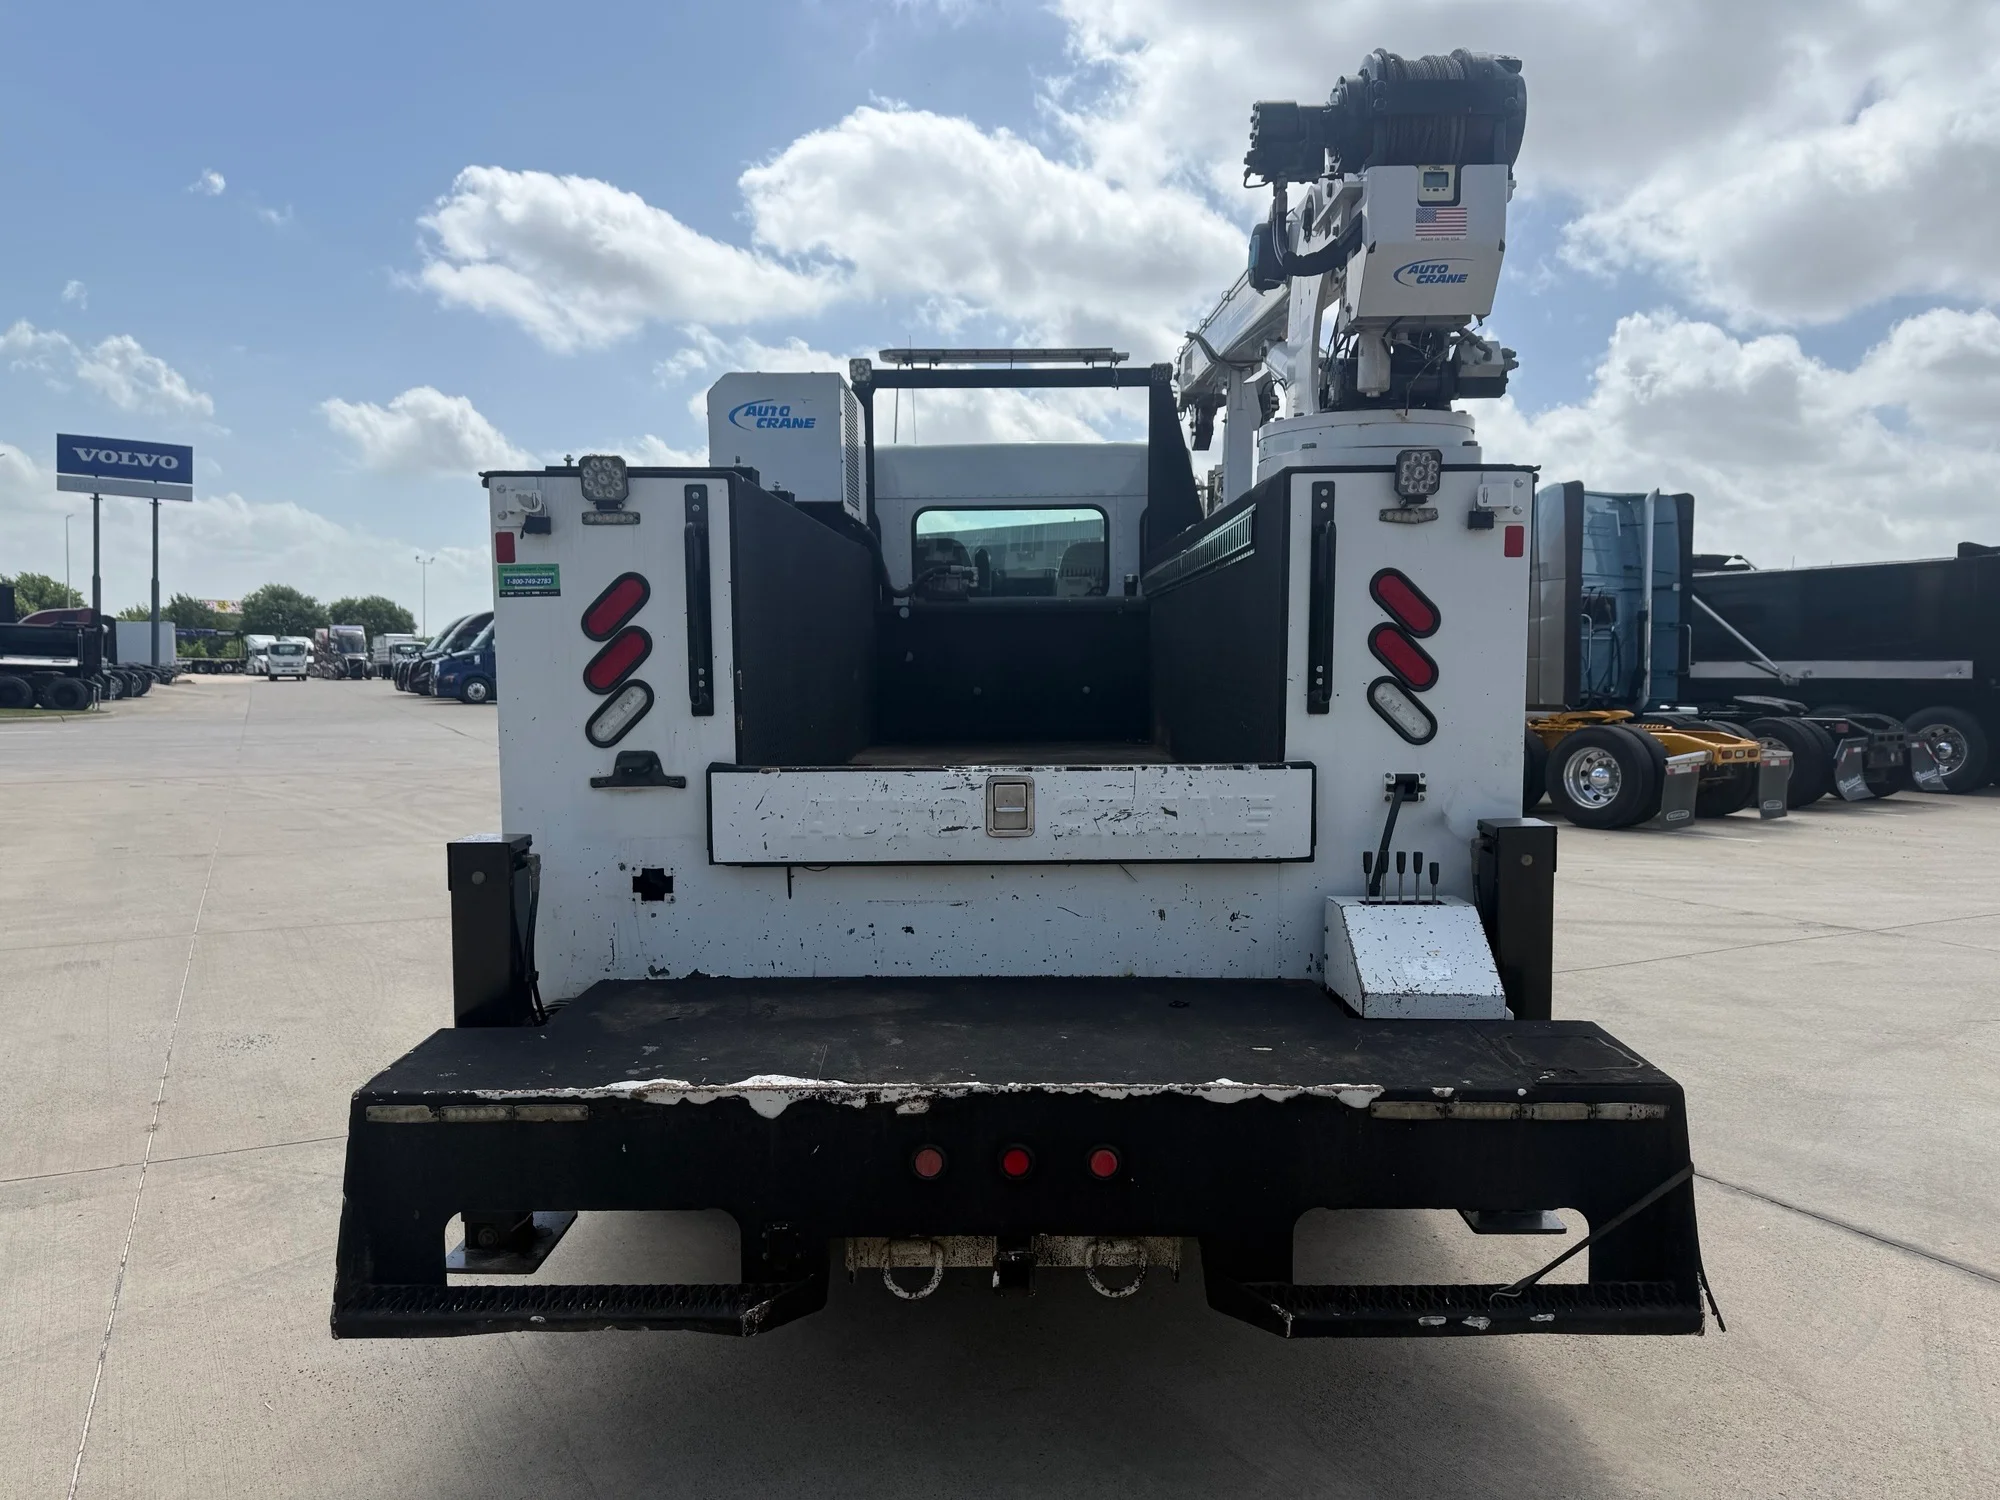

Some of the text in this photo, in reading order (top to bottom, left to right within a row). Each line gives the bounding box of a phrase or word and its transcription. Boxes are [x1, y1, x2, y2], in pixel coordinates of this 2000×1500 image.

[1407, 264, 1449, 275] AUTO
[1415, 273, 1469, 285] CRANE
[743, 405, 791, 417] AUTO
[756, 417, 816, 429] CRANE
[72, 447, 179, 470] VOLVO
